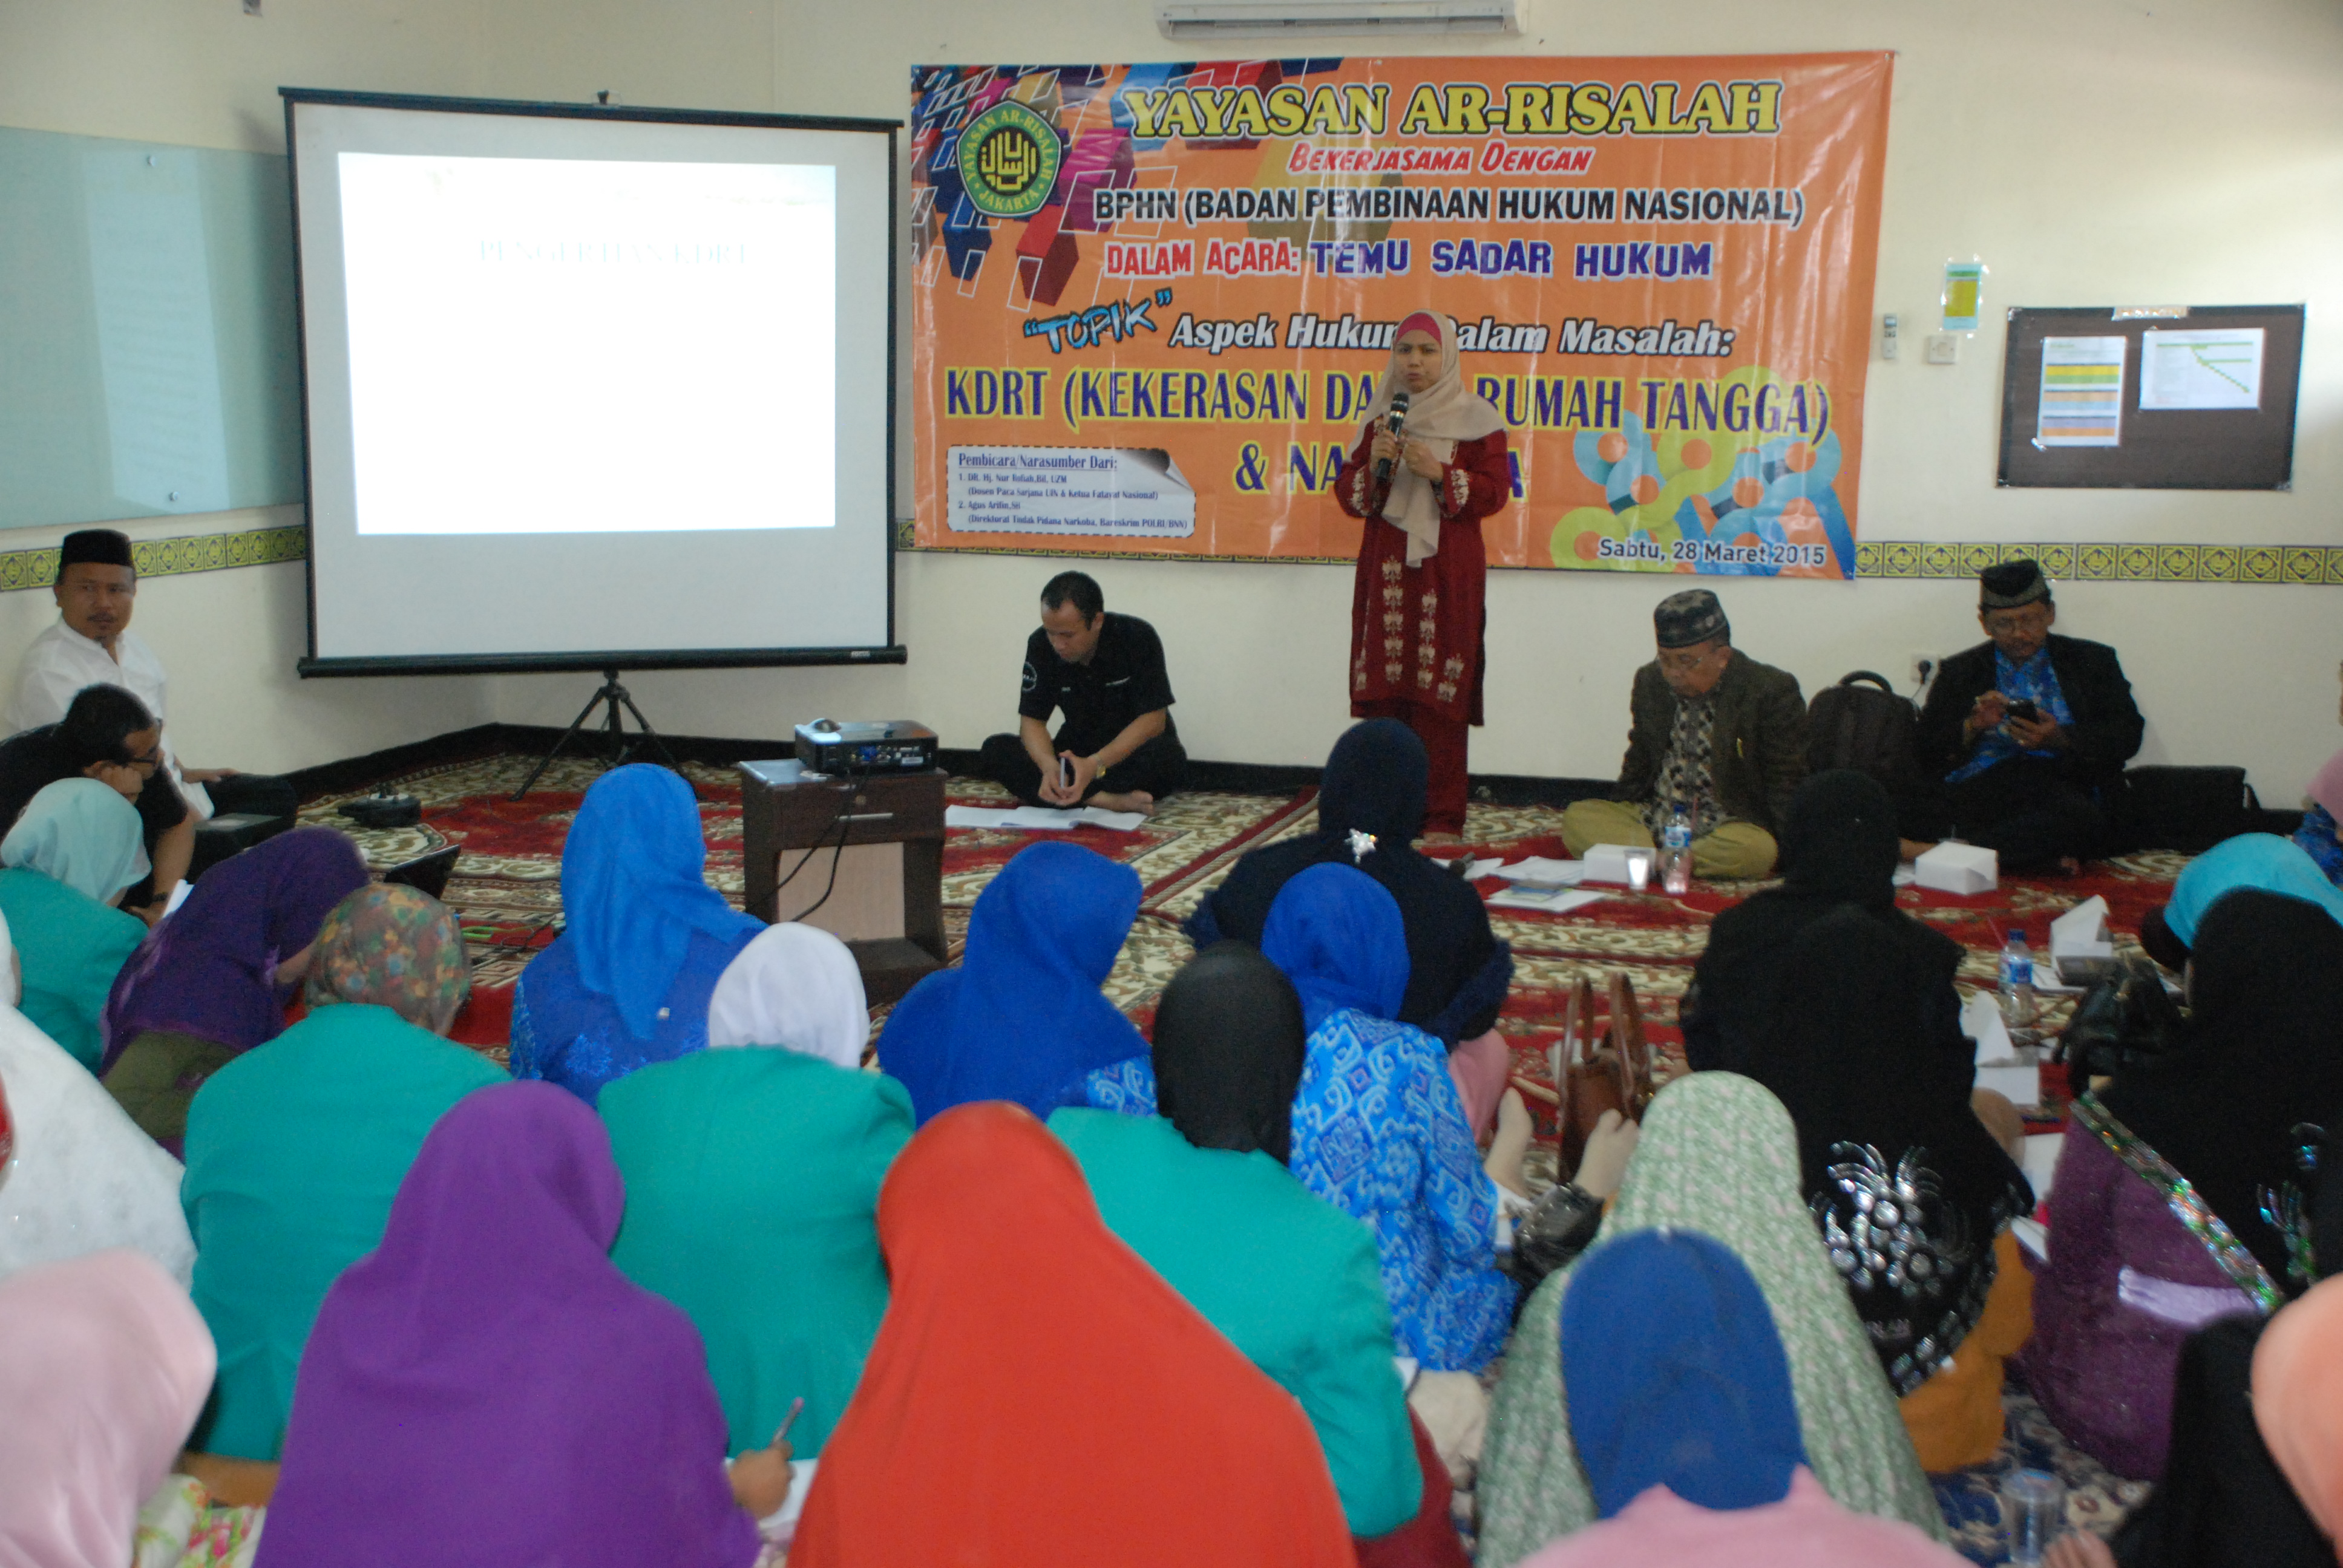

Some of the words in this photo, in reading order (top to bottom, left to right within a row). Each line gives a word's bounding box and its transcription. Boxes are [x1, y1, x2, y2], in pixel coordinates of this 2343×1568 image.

[1124, 85, 1389, 138] YAYASAN
[1400, 82, 1783, 134] AR-RISALAH
[963, 113, 996, 181] YAYASAN
[1000, 109, 1054, 180] AR-RISALAH
[1289, 145, 1470, 174] BEKERJASAMA
[1480, 142, 1594, 173] DENGAN
[978, 188, 1040, 211] JAKARTA
[1095, 189, 1177, 221] BPHN
[1185, 189, 1297, 226] (BADAN
[1305, 188, 1489, 223] PEMBINAAN
[1498, 188, 1615, 222] HUKUM
[1624, 189, 1804, 227] NASIONAL)
[1106, 241, 1194, 276] DALAM
[1204, 240, 1301, 276] ACARA:
[1311, 240, 1409, 278] TEMU
[1432, 239, 1552, 279] SADAR
[1575, 243, 1713, 281] HUKUM
[1169, 314, 1278, 354] Aspek
[1559, 318, 1737, 357] Masalah:
[945, 367, 1052, 419] KDRT
[1061, 365, 1310, 434] (KEKERASAN
[1640, 378, 1832, 449] TANGGA)
[958, 452, 1086, 469] Pembicara/Narasumber
[1090, 455, 1118, 469] Dari:
[996, 474, 1009, 482] Nur
[1233, 439, 1271, 495] &
[968, 500, 986, 511] Agus
[1100, 517, 1140, 528] Bareskrim
[1598, 535, 1665, 563] Sabtu,
[1673, 540, 1697, 561] 28
[1702, 541, 1769, 564] Maret
[1772, 544, 1826, 565] 2015
